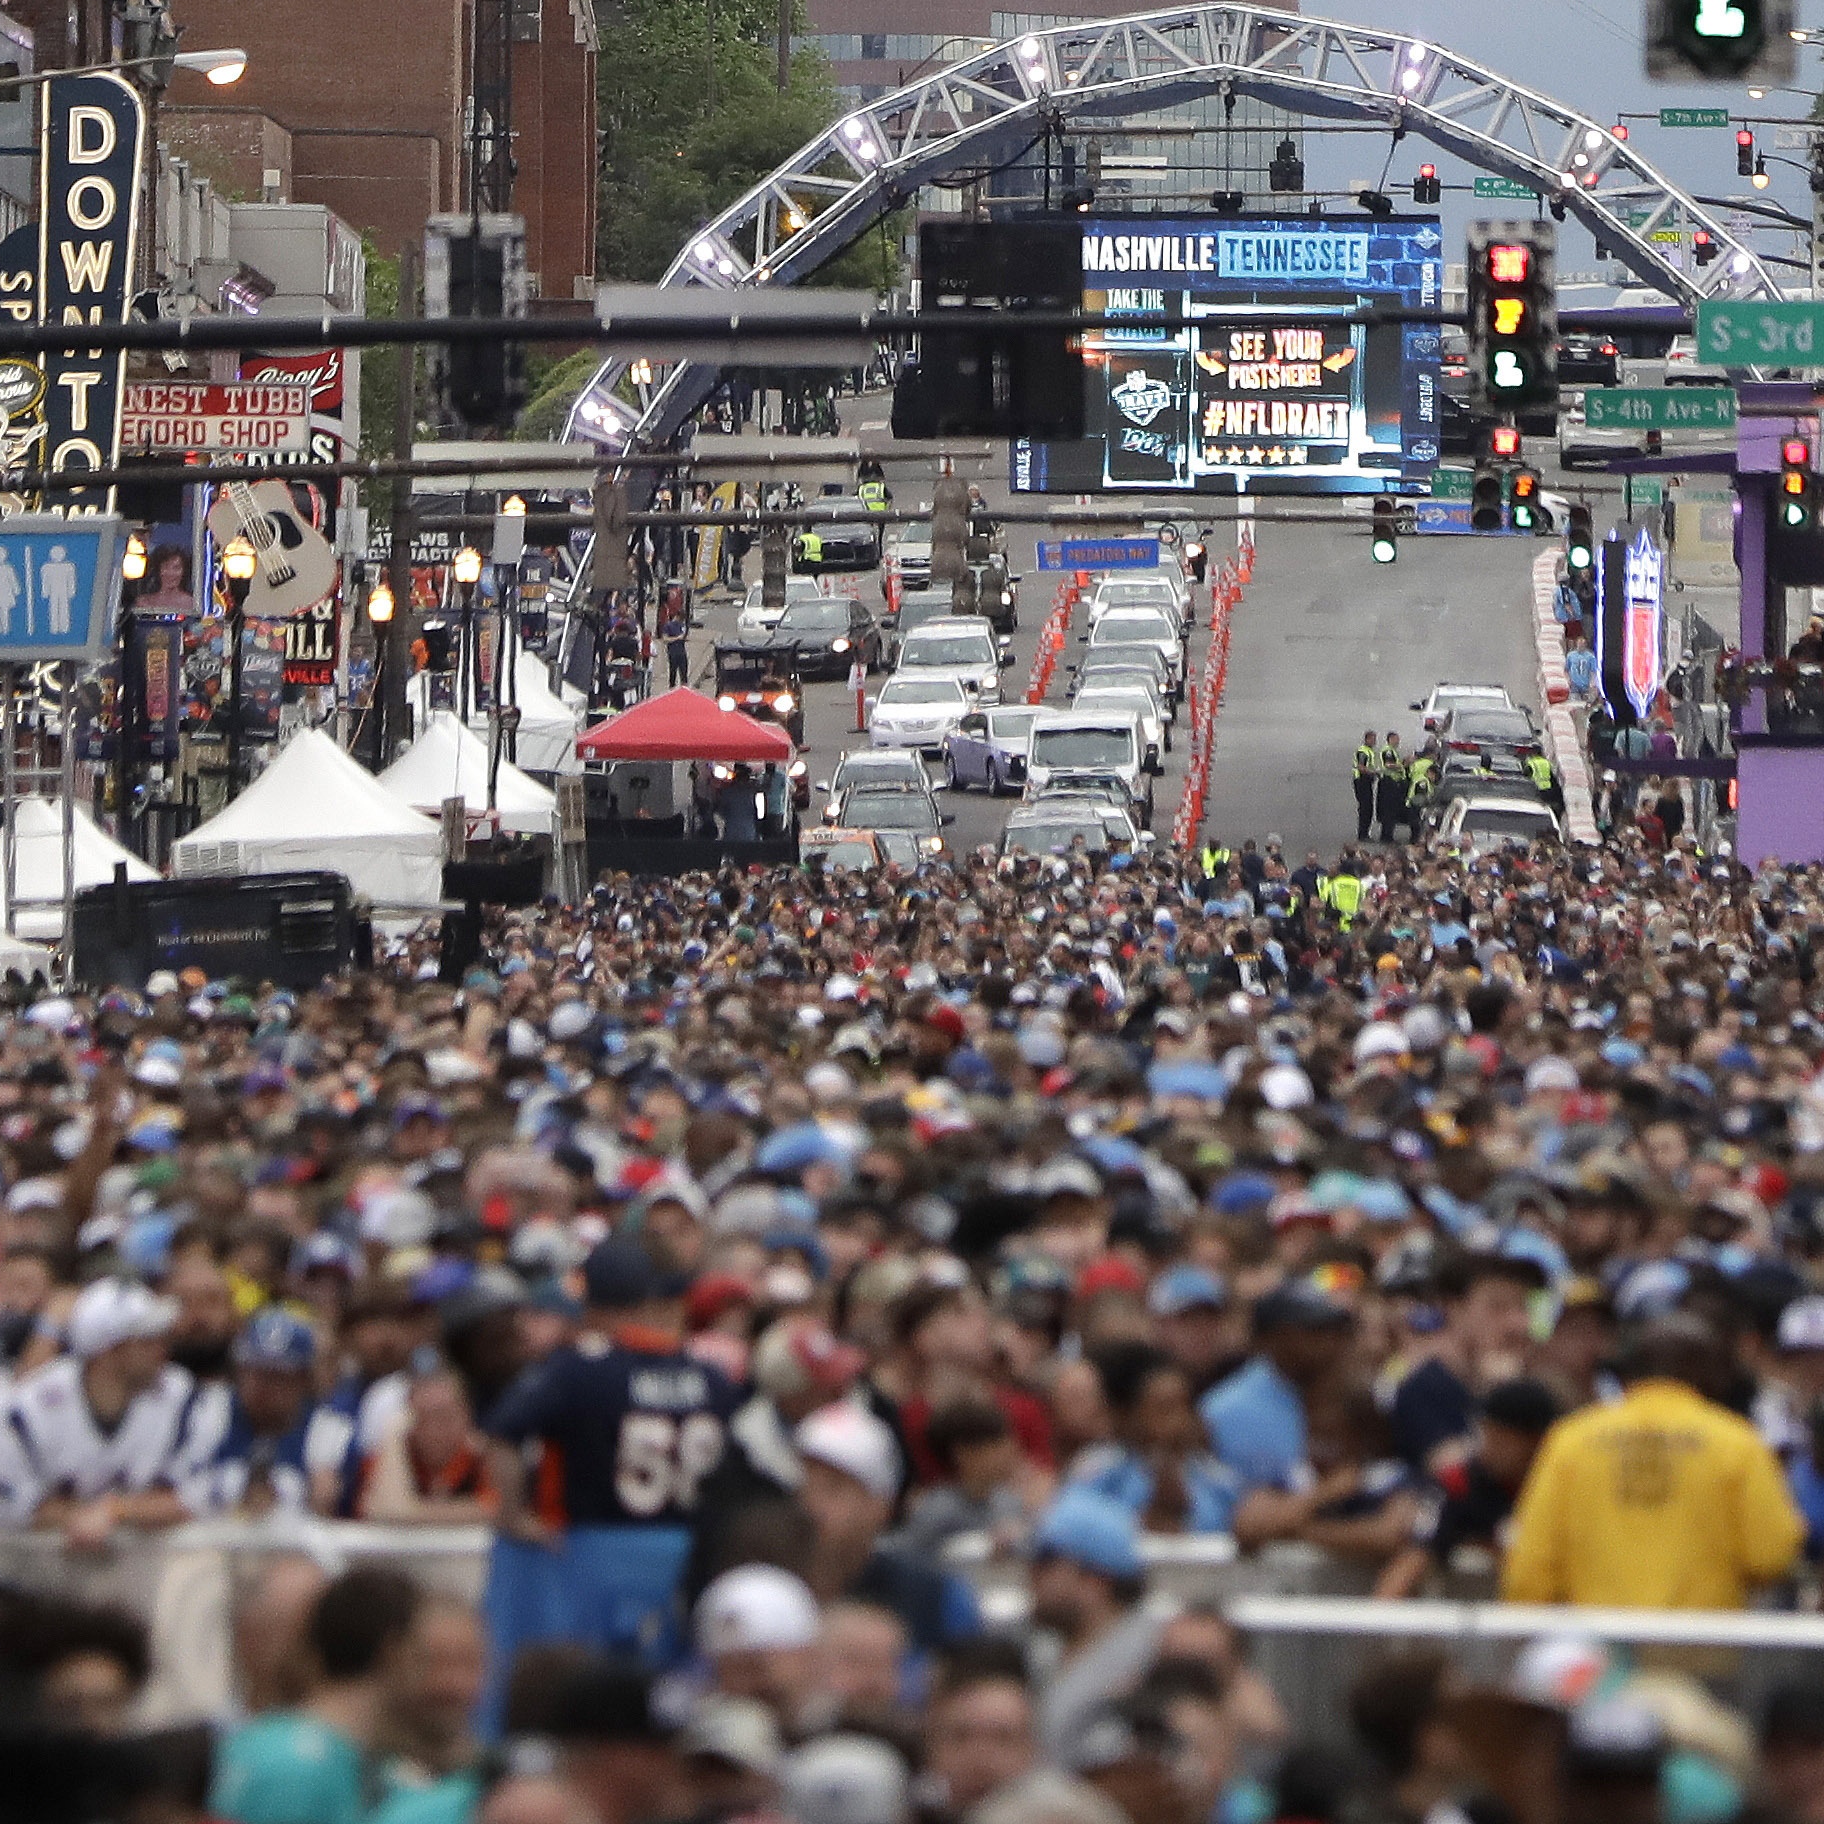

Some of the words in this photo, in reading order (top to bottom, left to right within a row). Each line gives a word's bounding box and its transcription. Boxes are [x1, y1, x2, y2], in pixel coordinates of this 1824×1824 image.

[1081, 235, 1215, 272] NASHVILLE
[1225, 237, 1361, 273] TENNESSEE
[1106, 288, 1139, 309] TAKE
[1229, 333, 1266, 362] SEE
[1272, 329, 1323, 362] YOUR
[1228, 363, 1277, 390] POSTS
[224, 384, 305, 415] TUBB
[219, 419, 290, 447] SHOP
[1203, 400, 1351, 438] #NFLDRAFT
